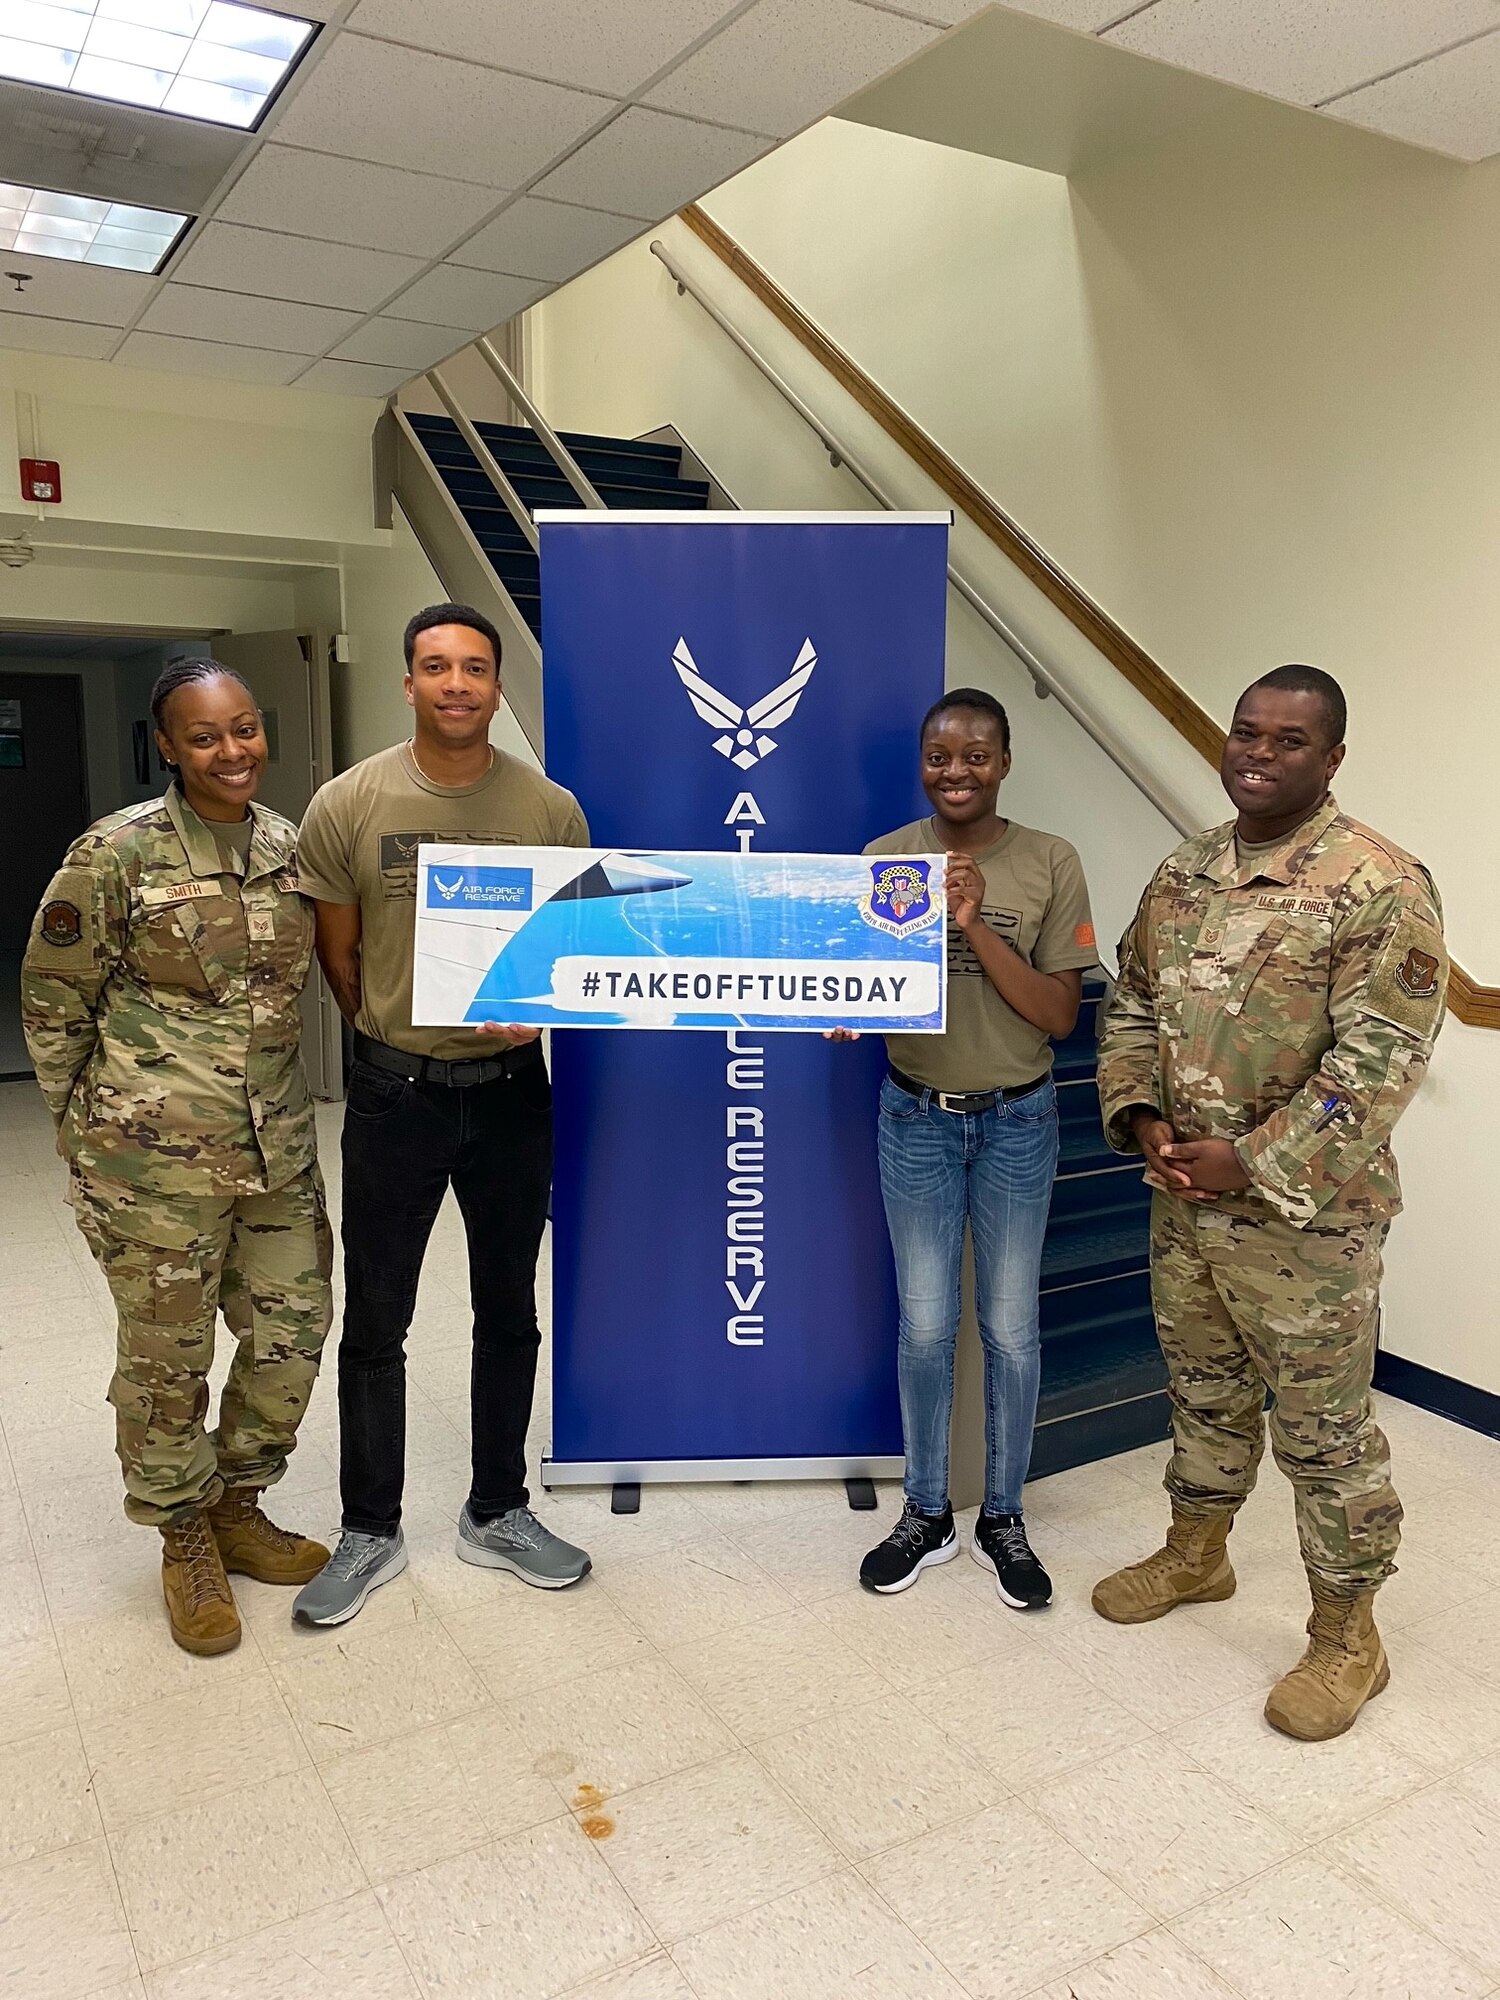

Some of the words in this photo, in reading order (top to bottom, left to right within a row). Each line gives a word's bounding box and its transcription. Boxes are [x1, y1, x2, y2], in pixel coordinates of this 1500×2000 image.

[165, 883, 203, 899] SMITH
[461, 885, 482, 894] AIR
[485, 886, 525, 895] FORCE
[464, 893, 521, 903] RESERVE
[1258, 895, 1275, 909] U.S.
[1278, 898, 1297, 911] AIR
[1299, 899, 1330, 915] FORCE
[581, 971, 908, 1003] #TAKEOFFTUESDAY
[725, 1106, 766, 1346] RESERVE
